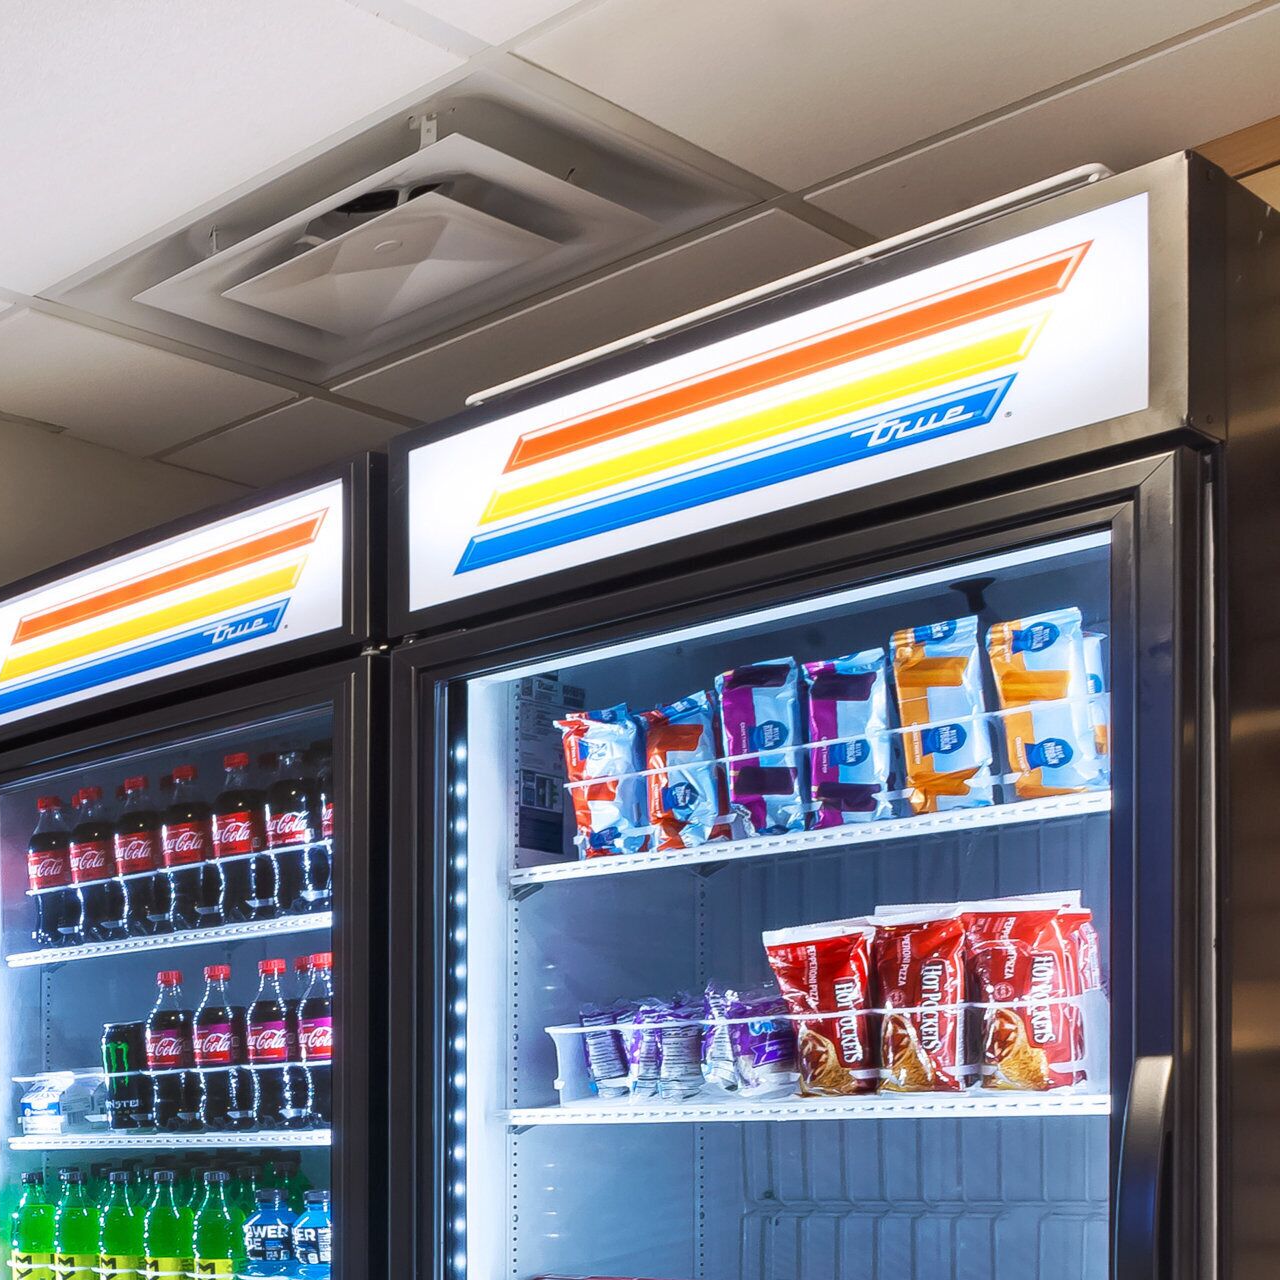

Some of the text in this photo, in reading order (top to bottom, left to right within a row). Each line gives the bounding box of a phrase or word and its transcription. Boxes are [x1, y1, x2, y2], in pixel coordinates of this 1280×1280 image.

[851, 404, 977, 447] true
[203, 615, 272, 644] true
[841, 1016, 862, 1063] OCKETS
